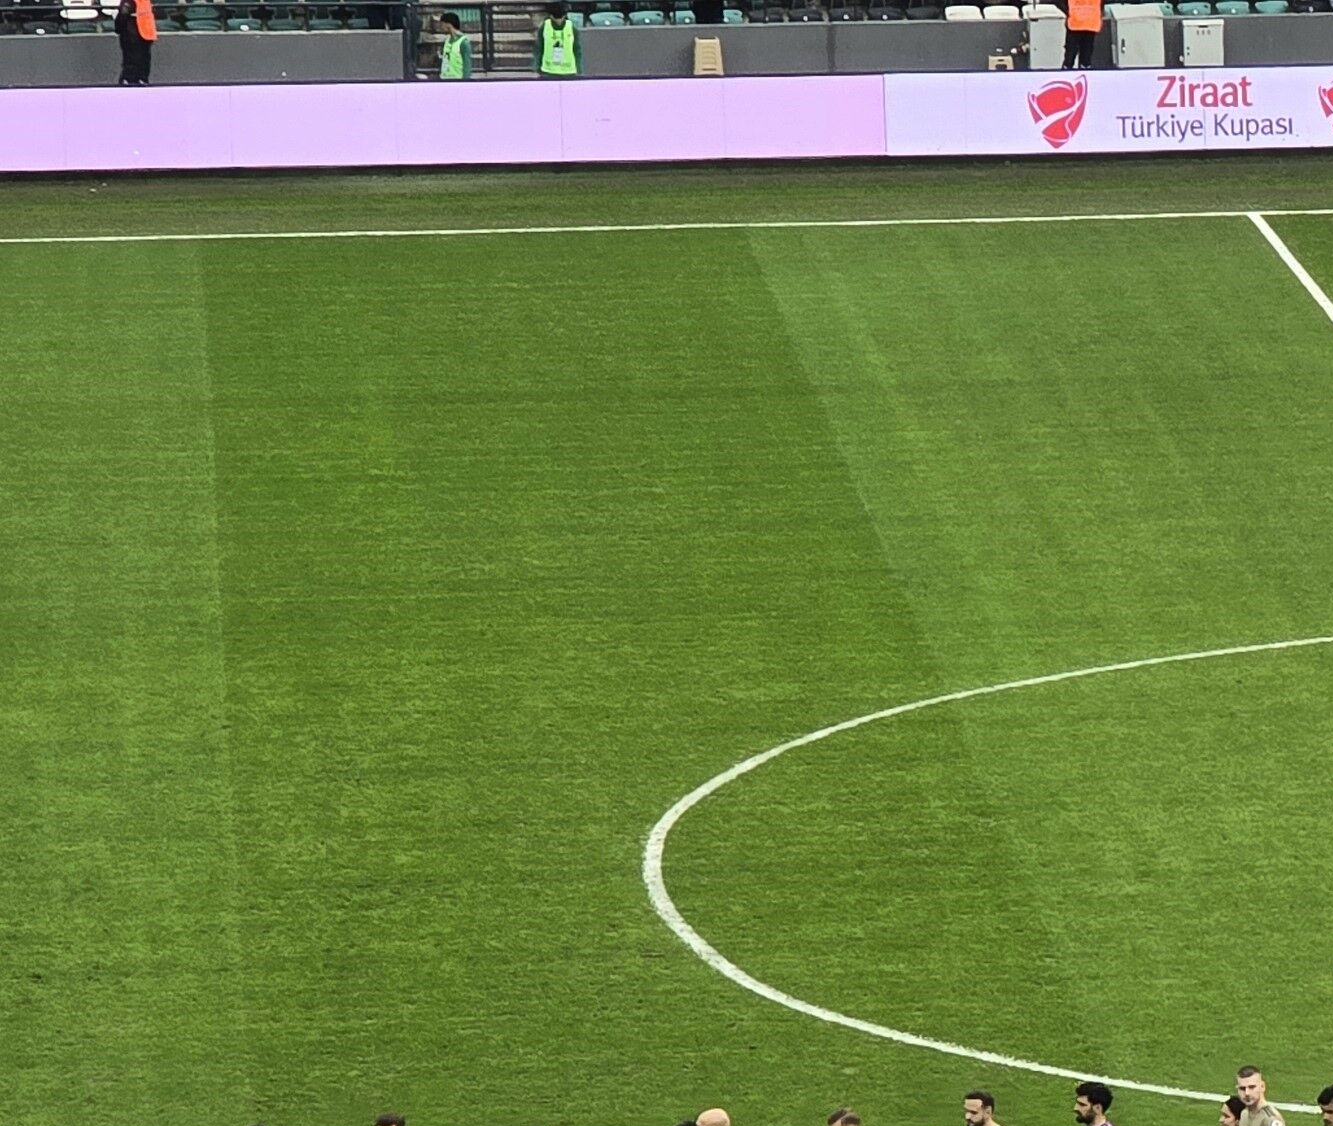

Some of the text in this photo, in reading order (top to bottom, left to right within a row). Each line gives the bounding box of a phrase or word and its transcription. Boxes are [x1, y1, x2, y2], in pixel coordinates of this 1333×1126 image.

[1156, 75, 1253, 108] Ziraat
[1116, 113, 1293, 143] Türkiye Kupası
